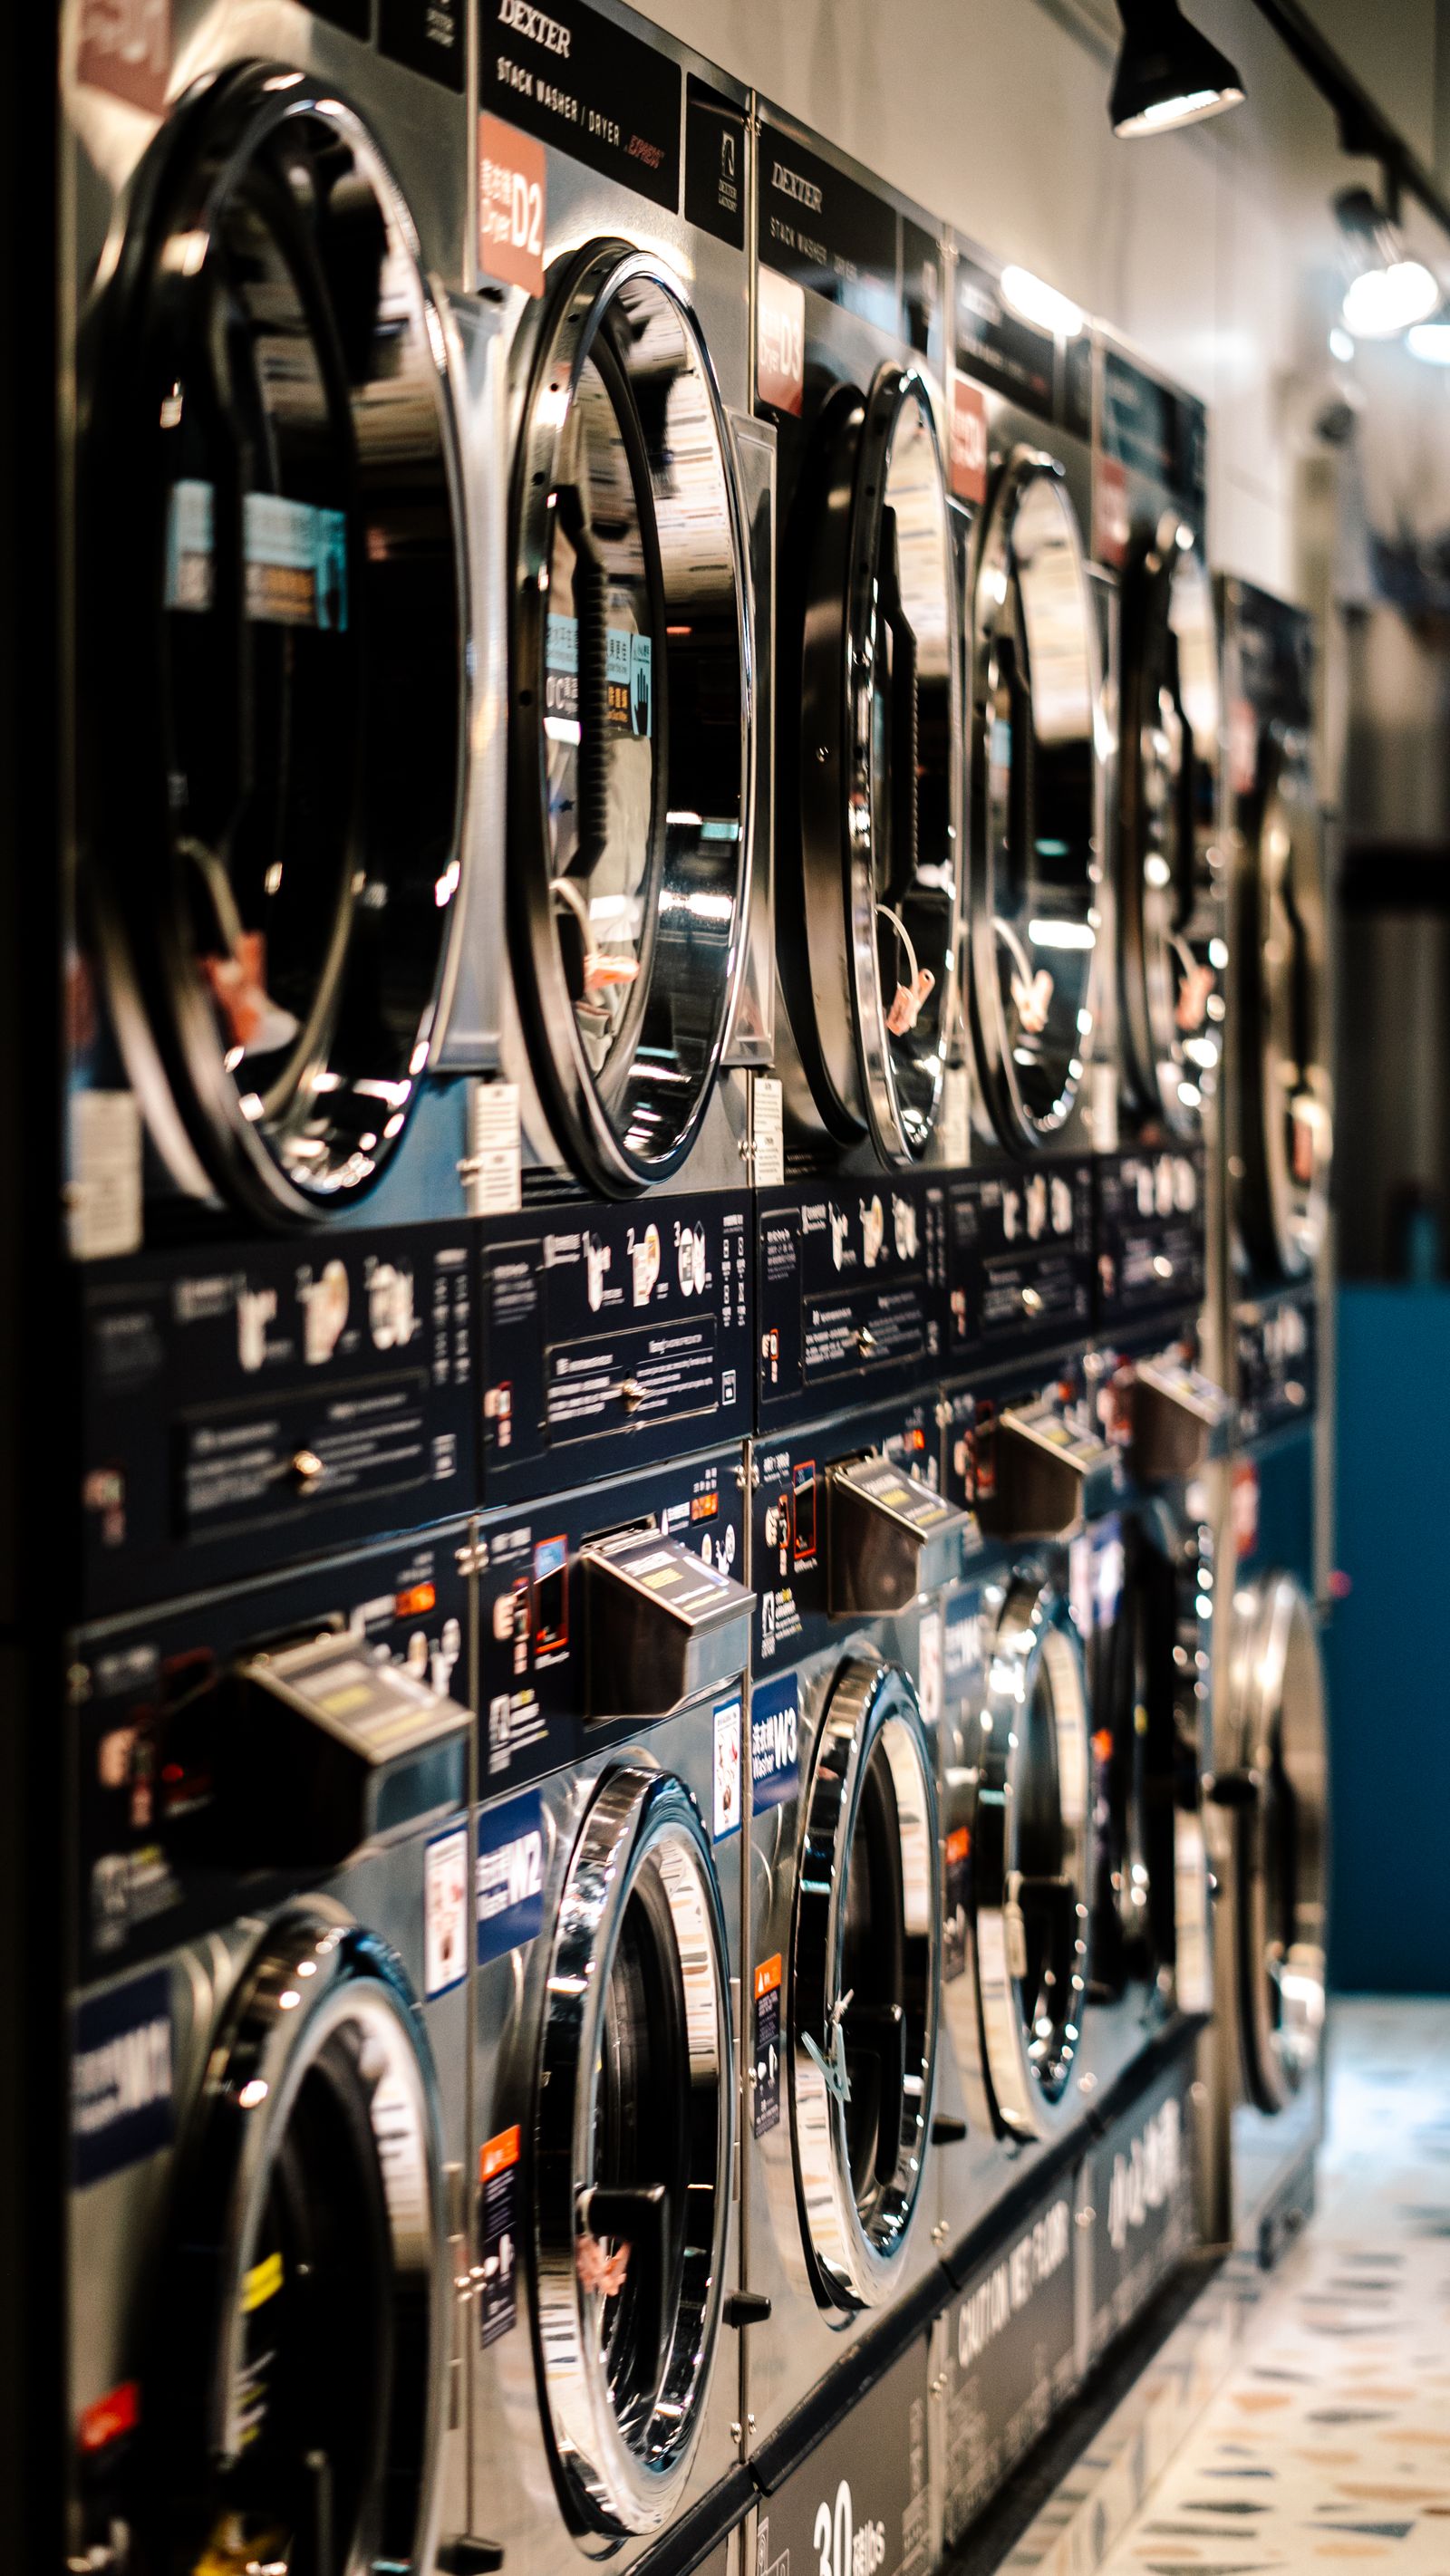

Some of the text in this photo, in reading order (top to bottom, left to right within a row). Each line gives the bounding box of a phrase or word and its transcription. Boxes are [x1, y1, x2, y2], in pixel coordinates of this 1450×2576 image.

[498, 0, 571, 58] DEXTER
[498, 56, 533, 96] STACK
[536, 79, 577, 121] WASHER
[589, 110, 620, 147] DRYER
[511, 172, 542, 256] D2
[770, 161, 823, 214] DEXTER
[773, 1707, 798, 1769] W3
[813, 2479, 853, 2576] 30
